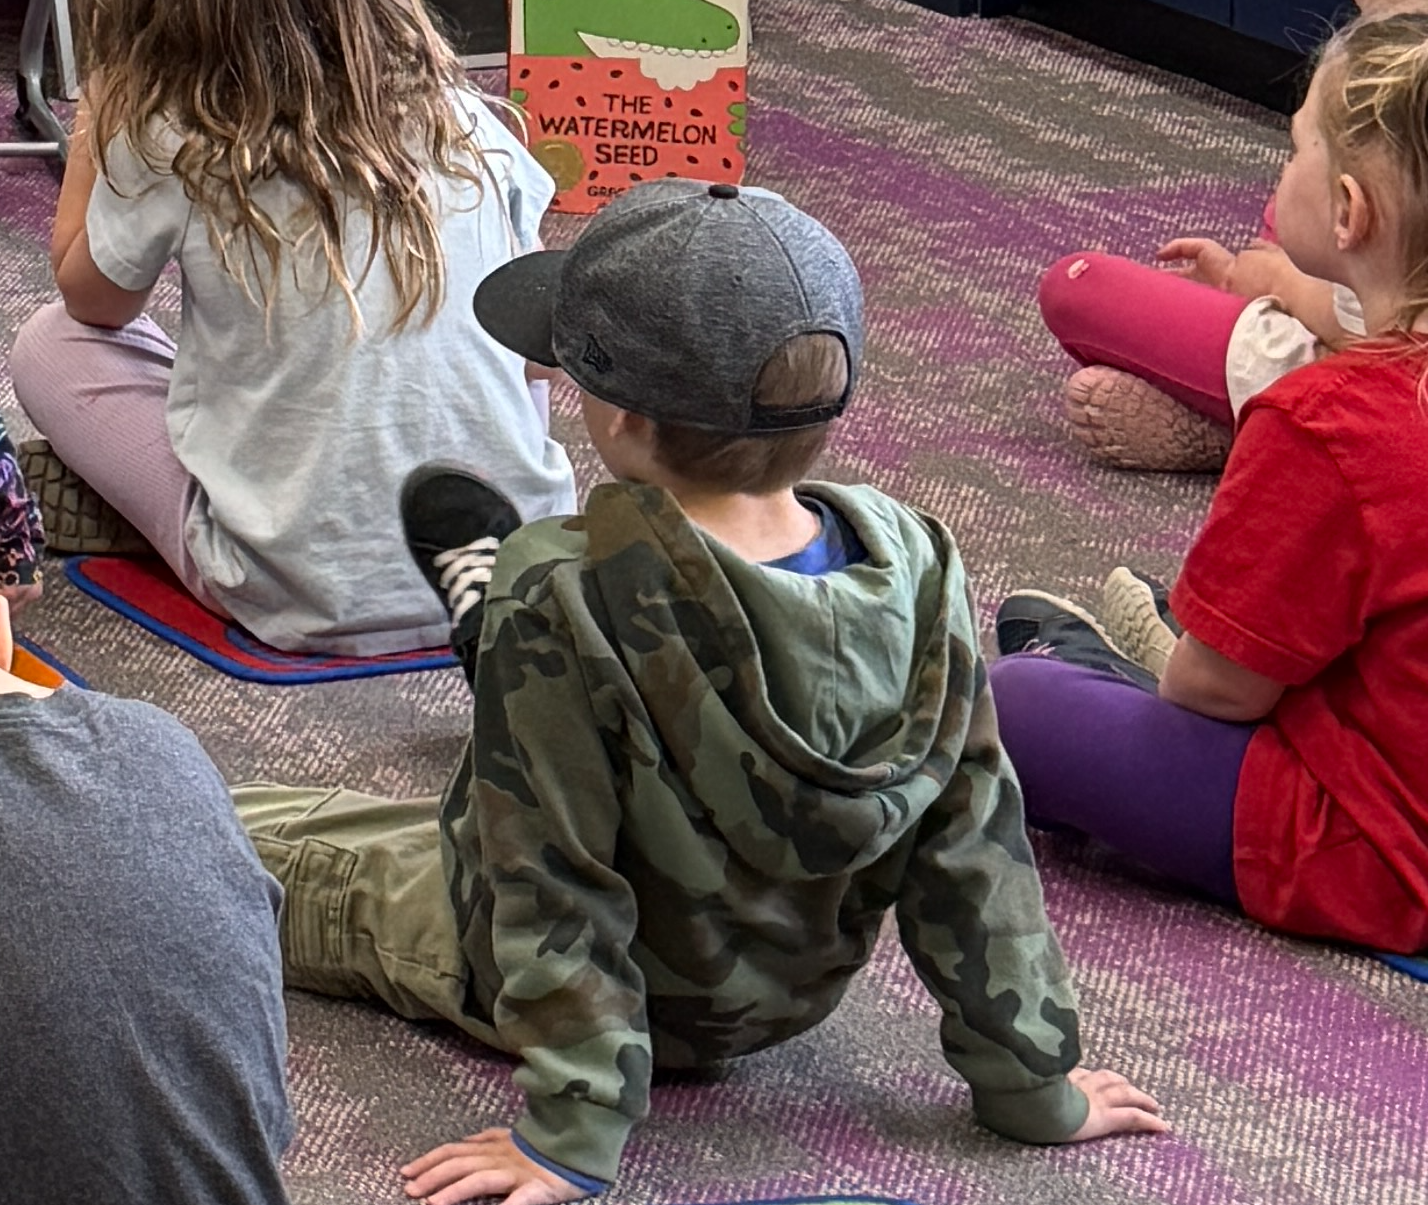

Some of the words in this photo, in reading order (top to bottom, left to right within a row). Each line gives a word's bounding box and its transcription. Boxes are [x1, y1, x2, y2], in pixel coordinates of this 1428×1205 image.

[603, 94, 653, 114] THE
[539, 114, 716, 145] WATERMELON
[595, 144, 658, 166] SEED
